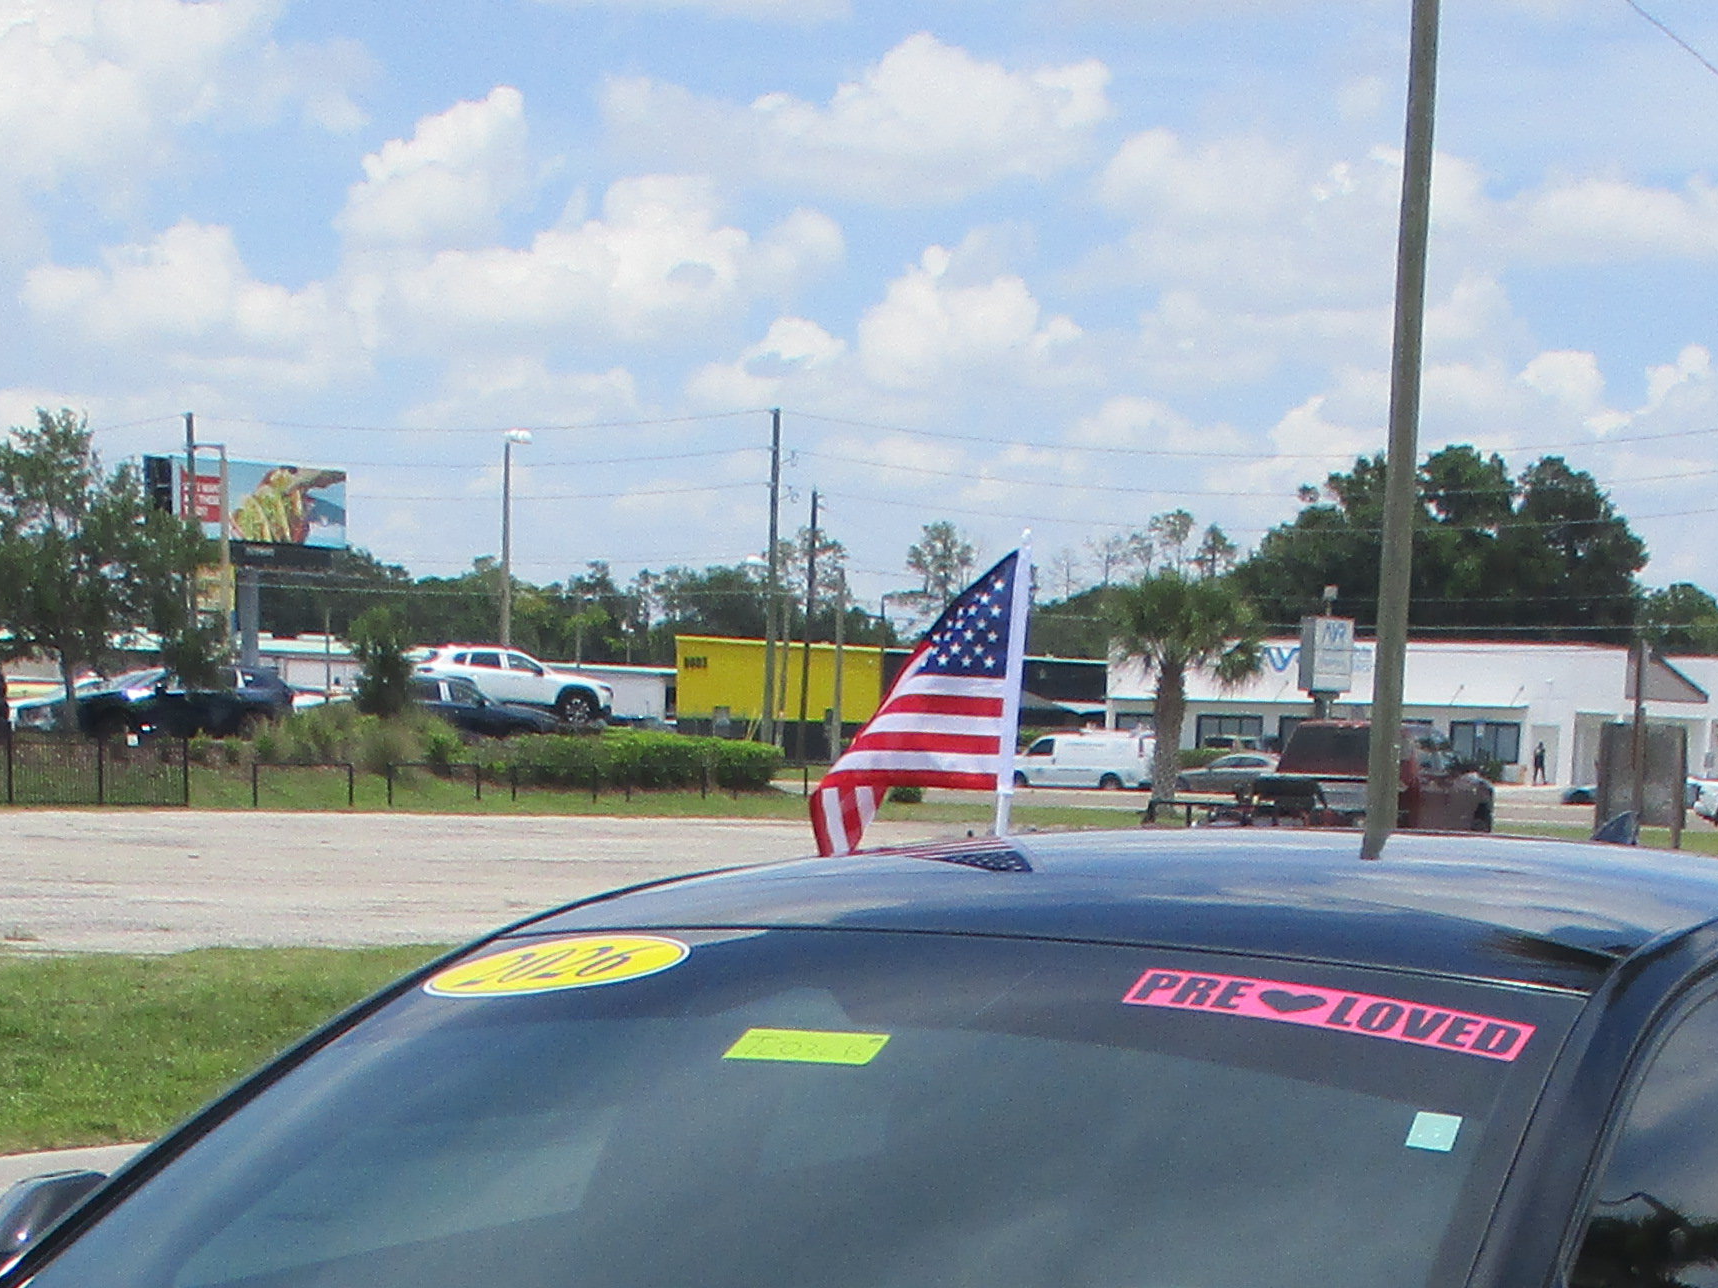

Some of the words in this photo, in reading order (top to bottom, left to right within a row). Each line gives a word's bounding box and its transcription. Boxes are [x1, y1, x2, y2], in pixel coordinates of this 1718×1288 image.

[450, 944, 670, 988] 2026
[1133, 972, 1257, 1009] PRE
[1326, 996, 1522, 1056] LOVED
